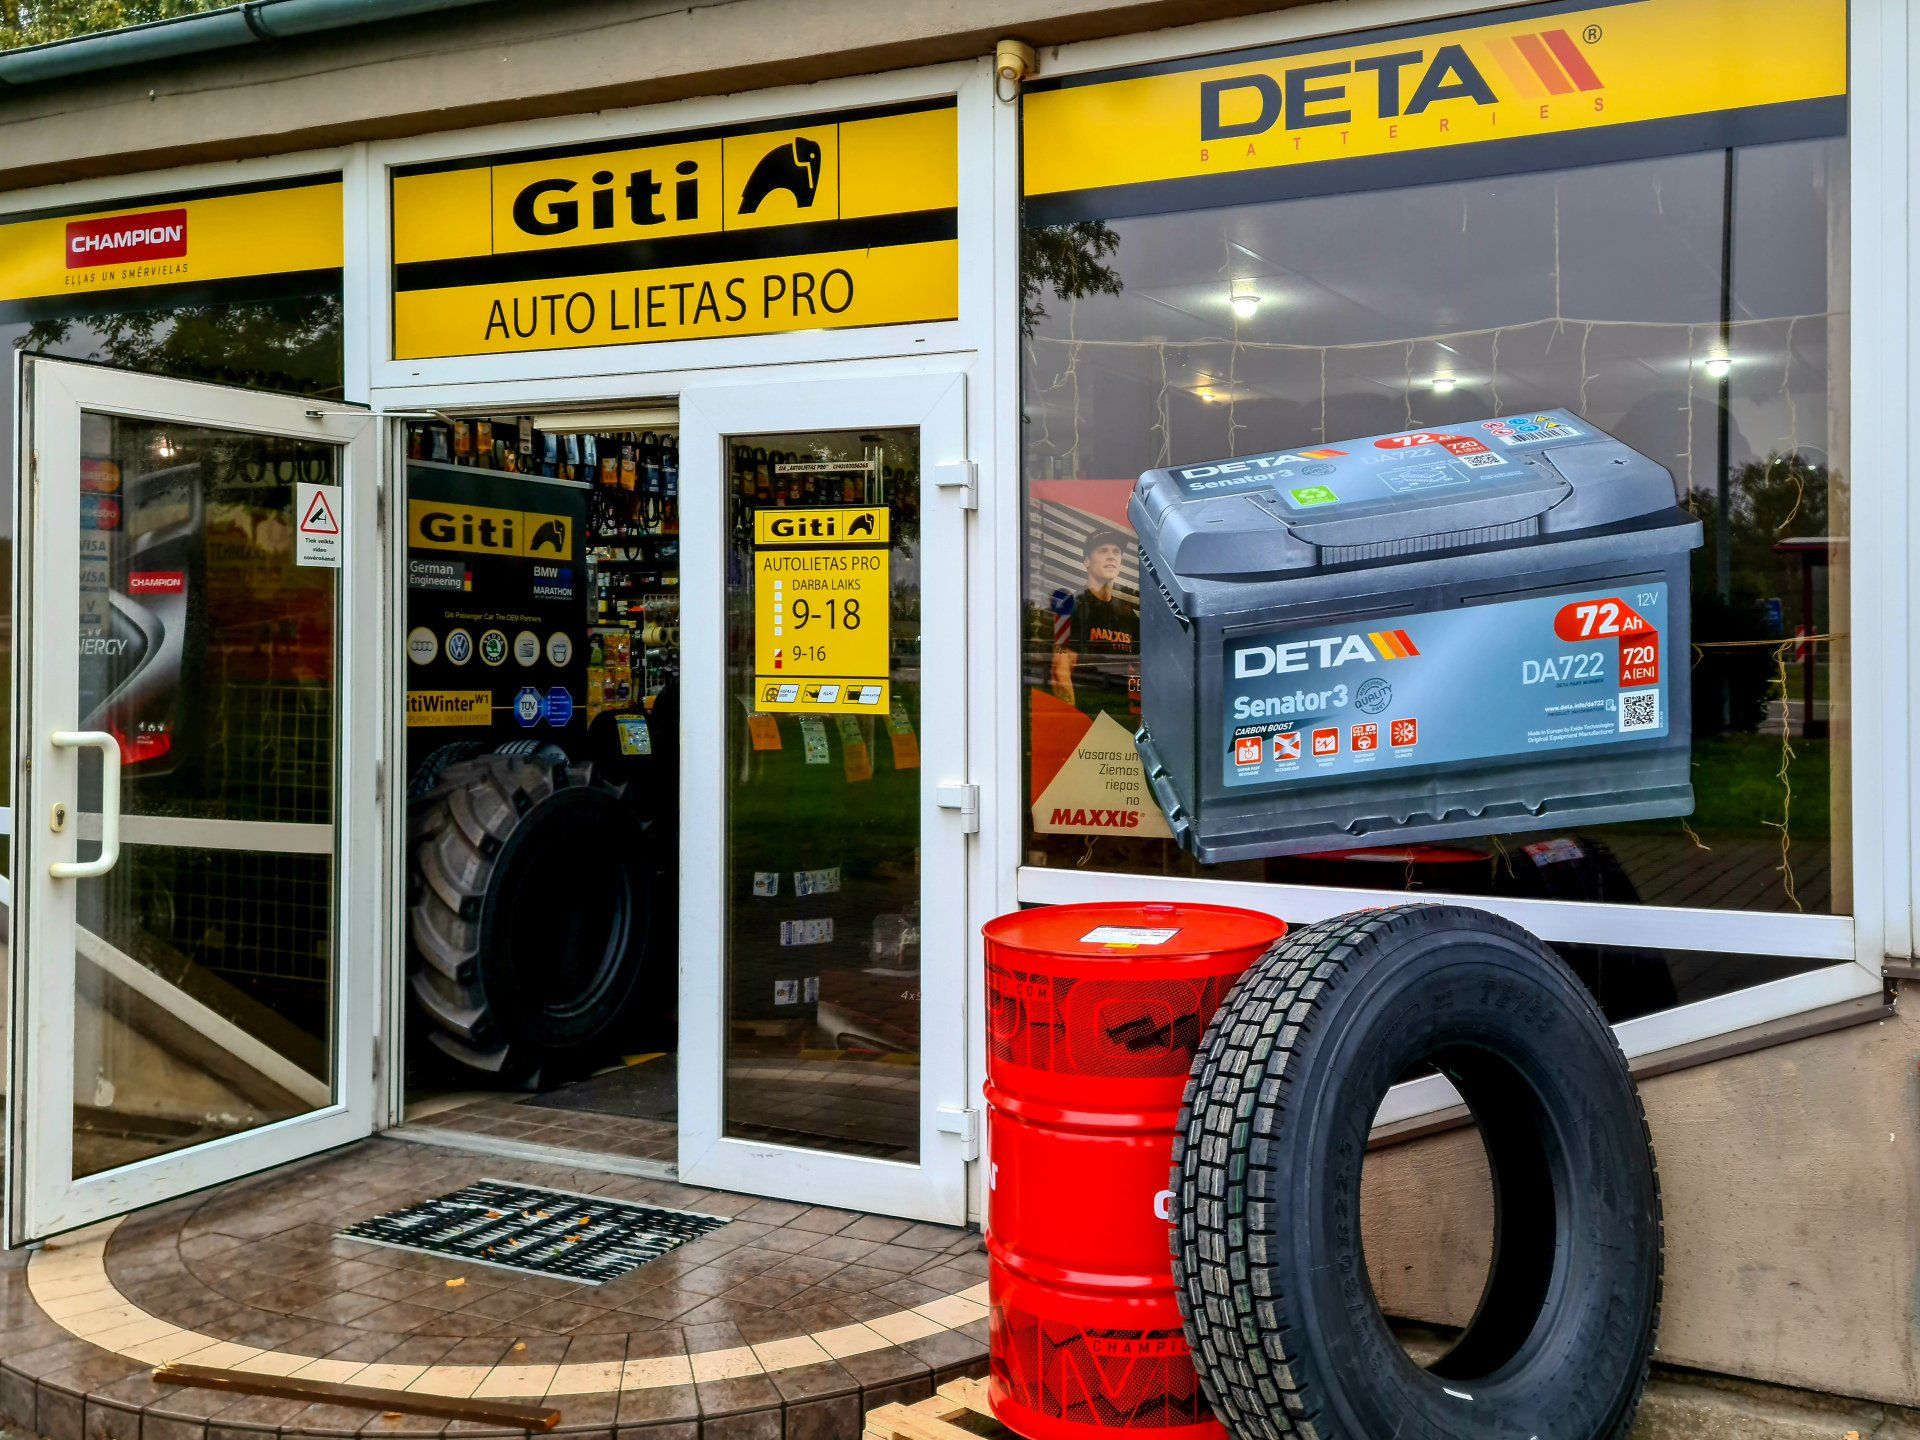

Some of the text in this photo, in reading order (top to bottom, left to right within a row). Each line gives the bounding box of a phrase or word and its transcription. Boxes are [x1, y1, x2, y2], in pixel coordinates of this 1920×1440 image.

[1200, 43, 1500, 142] DETA
[1200, 97, 1605, 163] BATTERIES
[512, 160, 699, 236] Giti
[72, 226, 182, 253] CHAMPION
[102, 271, 115, 282] UN
[122, 263, 189, 279] SMĒRVIELAS
[485, 268, 855, 341] AUTO LIETAS PRO
[1392, 434, 1436, 446] 72
[1447, 440, 1478, 449] 720
[1360, 448, 1436, 465] DA722
[1182, 454, 1311, 480] DETA
[1189, 469, 1295, 491] Senator3
[419, 512, 513, 549] Giti
[771, 517, 835, 537] Giti
[409, 560, 454, 575] German
[533, 566, 558, 578] BMW
[763, 555, 881, 572] AUTOLIETAS PRO
[131, 578, 181, 588] CHAMPION
[409, 575, 462, 589] Engineering
[792, 578, 861, 591] DARBA LAIKS
[533, 586, 573, 596] MARATHON
[1636, 591, 1659, 607] 12V
[792, 598, 861, 630] 9-18
[1576, 602, 1643, 637] 72 Ah
[1090, 627, 1131, 644] MAXXIS
[792, 645, 826, 661] 9-16
[1235, 634, 1376, 679] DETA
[1623, 645, 1655, 666] 720
[1522, 652, 1604, 685] DA722
[1623, 665, 1655, 680] A (EN)
[406, 693, 489, 712] itiWinter W1
[1234, 684, 1349, 720] Senator3
[1354, 683, 1393, 709] QUALITY
[521, 701, 536, 711] TÜV
[1235, 721, 1294, 736] CARBON BOOST
[1078, 748, 1139, 761] Vasaras un
[1098, 763, 1139, 776] Ziemas
[1105, 779, 1140, 793] riepas
[1126, 796, 1140, 806] no
[1050, 808, 1139, 828] MAXXIS
[1092, 1339, 1190, 1353] CHAMPIO
